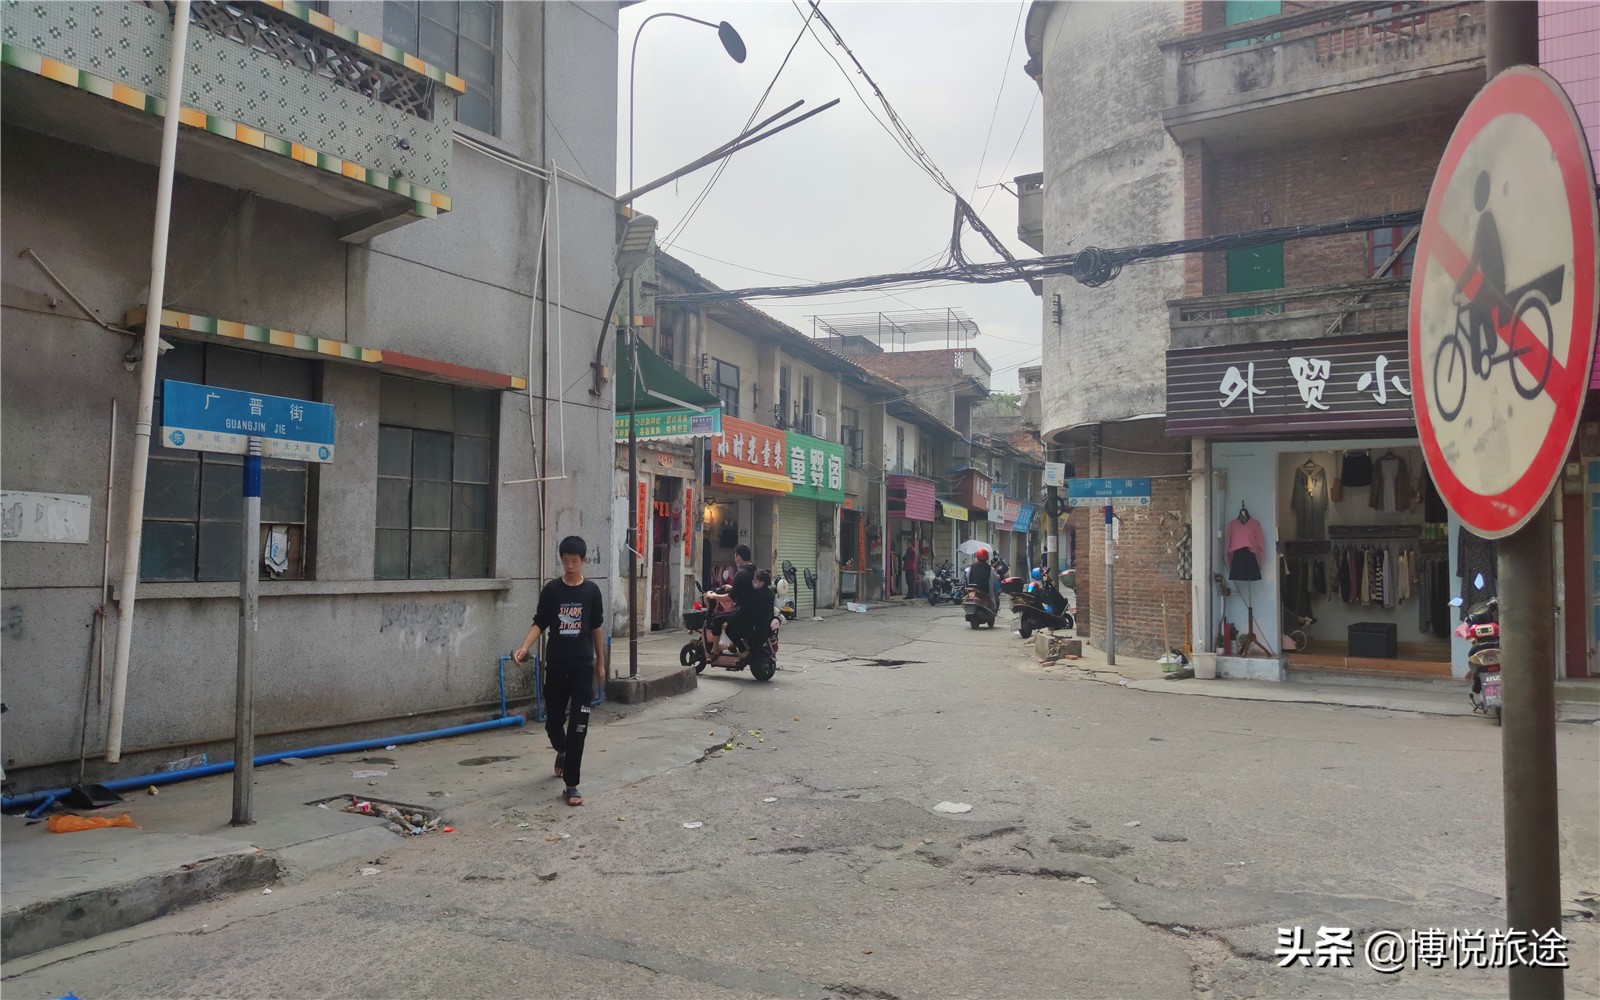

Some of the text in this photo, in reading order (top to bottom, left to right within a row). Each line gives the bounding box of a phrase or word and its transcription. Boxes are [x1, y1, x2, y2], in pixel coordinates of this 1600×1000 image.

[1219, 354, 1411, 413] 外贸小
[204, 392, 304, 422] 广晋街
[225, 418, 286, 435] GUANGJIN JIE
[173, 431, 183, 443] 东
[790, 446, 842, 491] 童婴阁
[560, 606, 582, 617] SHARK
[559, 622, 582, 630] ATTACK
